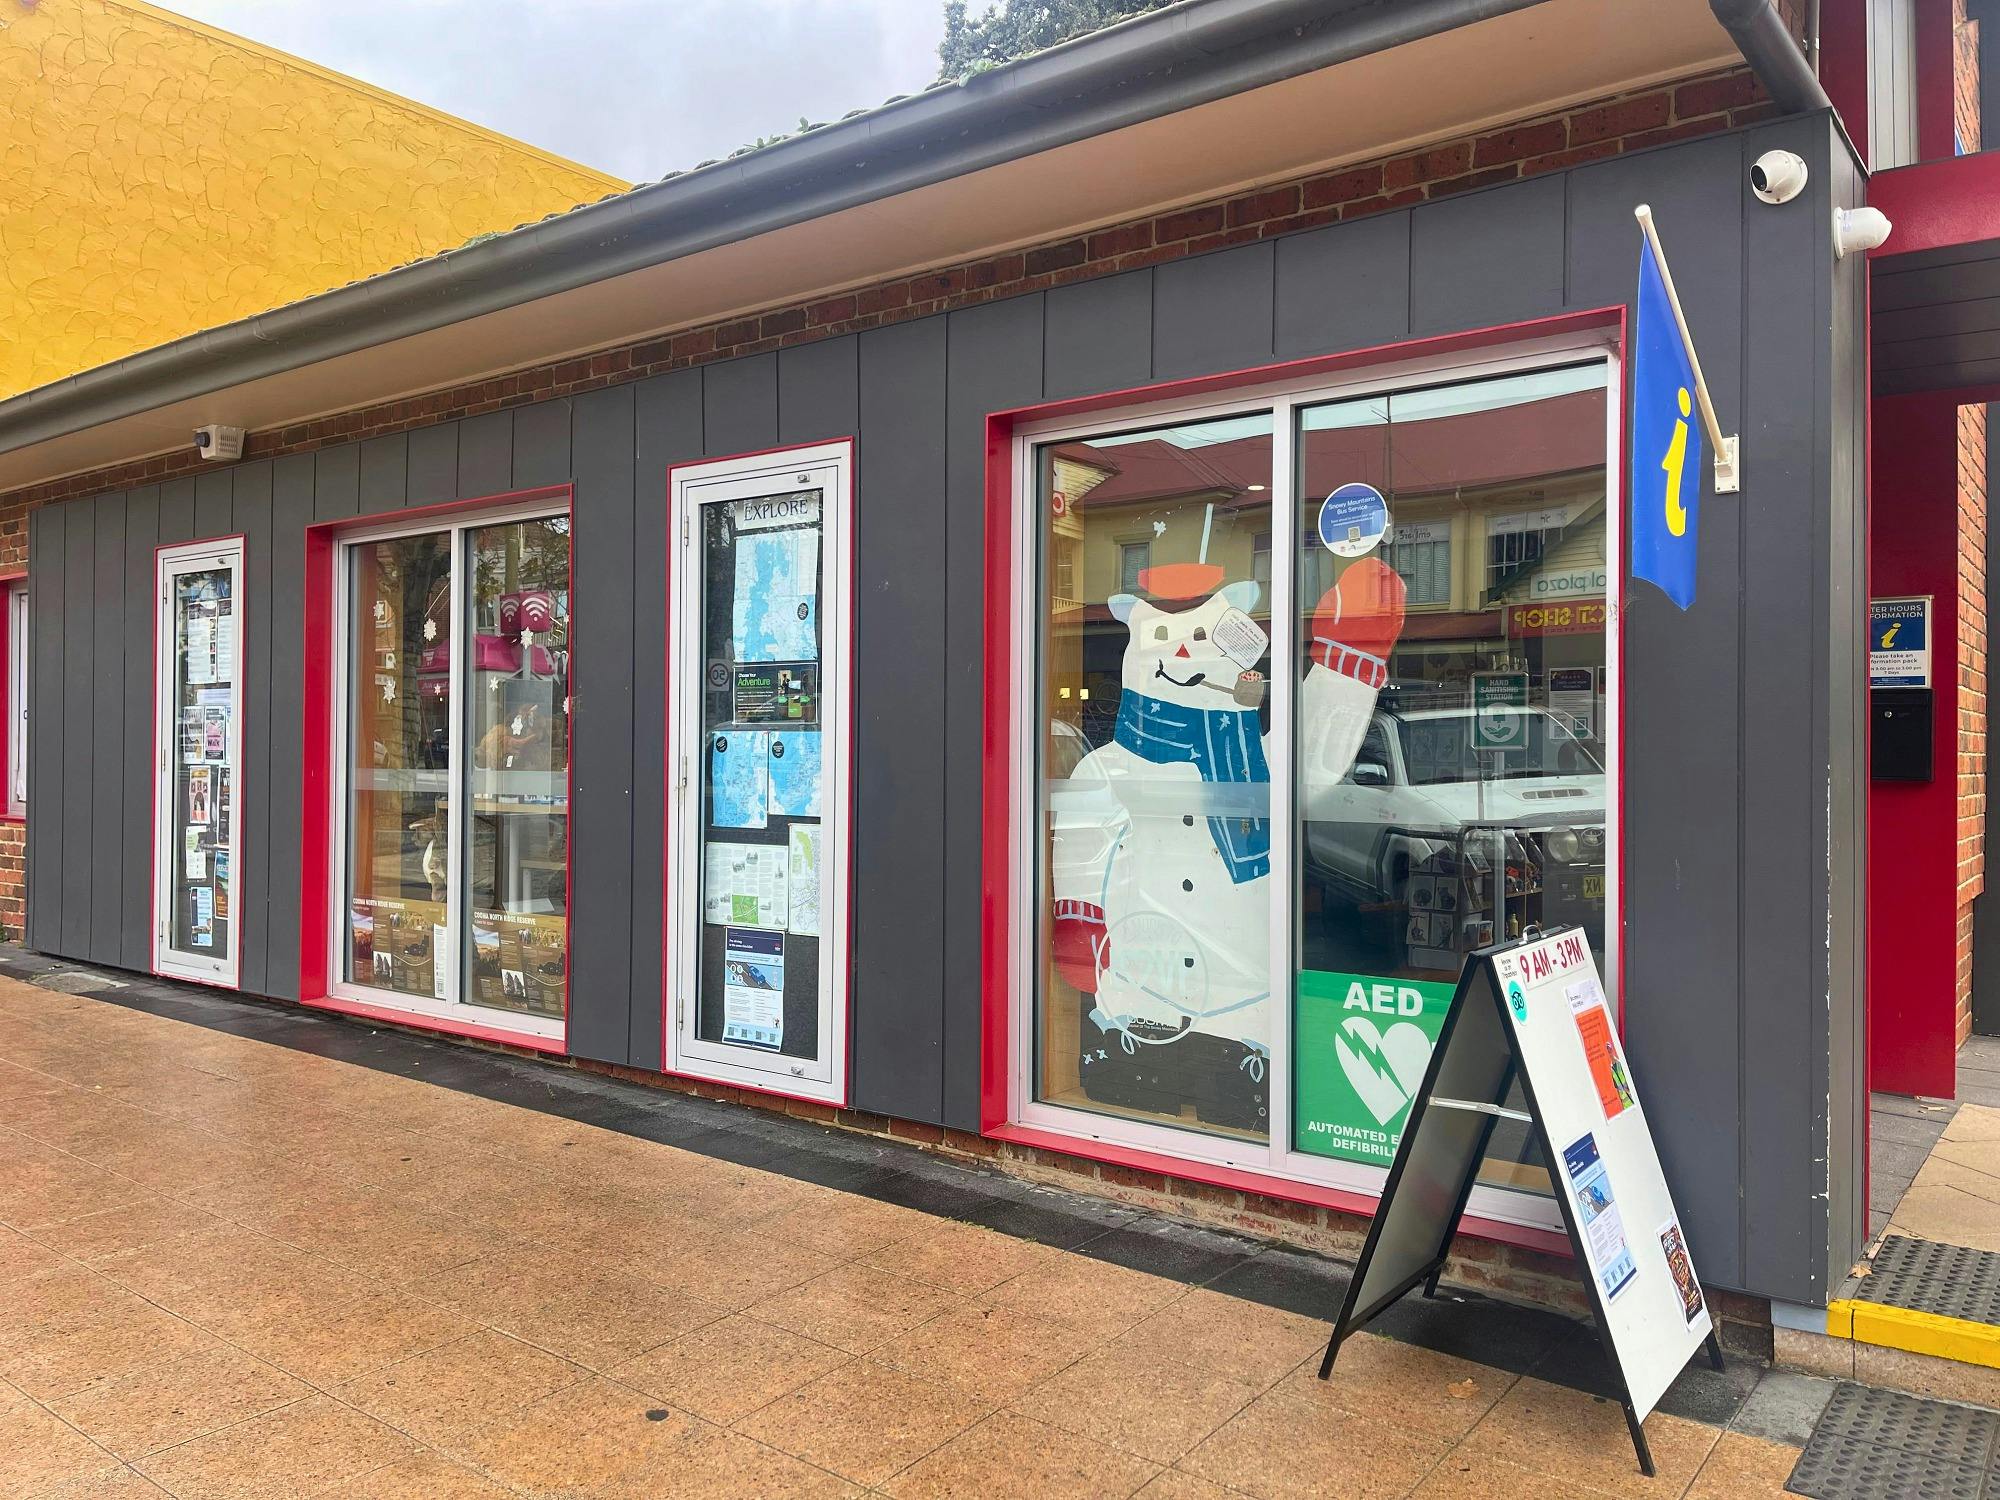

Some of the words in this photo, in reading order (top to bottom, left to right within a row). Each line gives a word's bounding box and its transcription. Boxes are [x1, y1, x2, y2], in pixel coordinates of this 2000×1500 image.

[1661, 387, 1692, 537] i
[1347, 496, 1375, 507] Mountains
[743, 498, 809, 521] EXPLORE
[1348, 504, 1368, 513] Service
[1889, 604, 1922, 612] HOURS
[1870, 611, 1923, 619] FORMATION
[737, 677, 771, 687] Adventure
[1489, 679, 1509, 687] HAND
[1519, 954, 1530, 982] 9
[1532, 947, 1553, 980] AM
[1342, 981, 1424, 1017] AED
[1307, 1120, 1387, 1143] AUTOMATED
